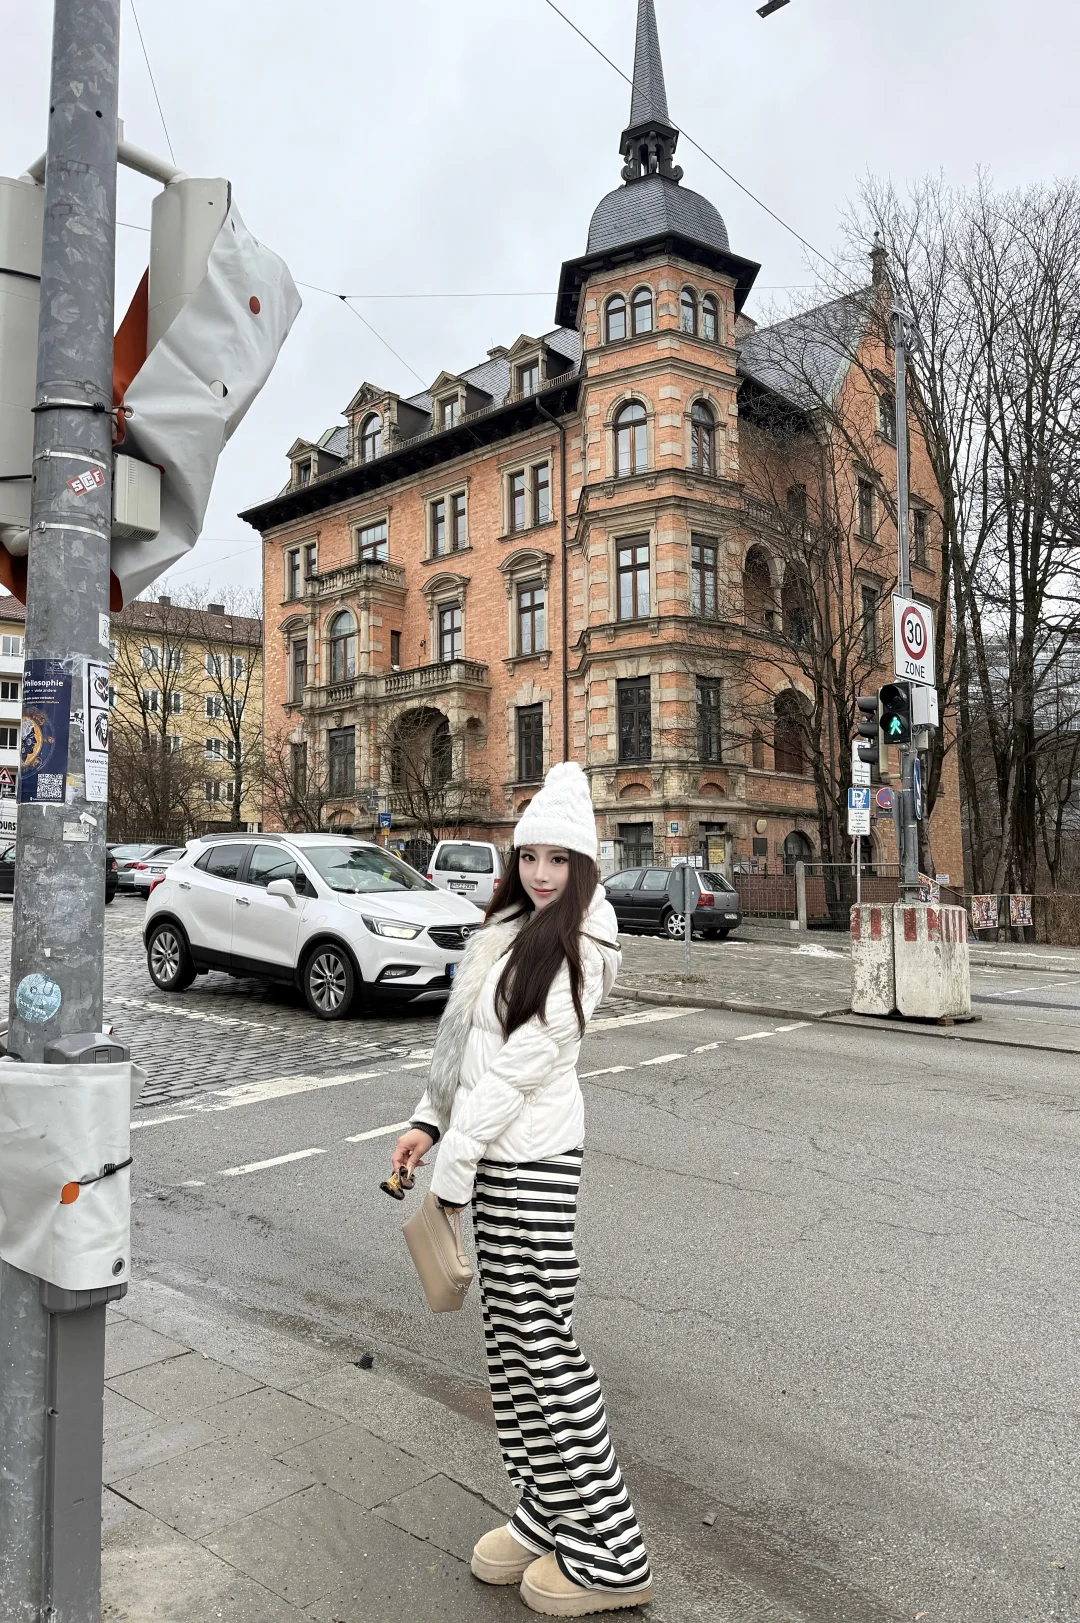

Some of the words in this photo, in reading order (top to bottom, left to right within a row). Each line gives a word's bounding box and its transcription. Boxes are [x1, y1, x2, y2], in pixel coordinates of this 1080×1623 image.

[71, 471, 101, 492] SCF
[907, 620, 922, 646] 30
[905, 661, 925, 678] ZONE
